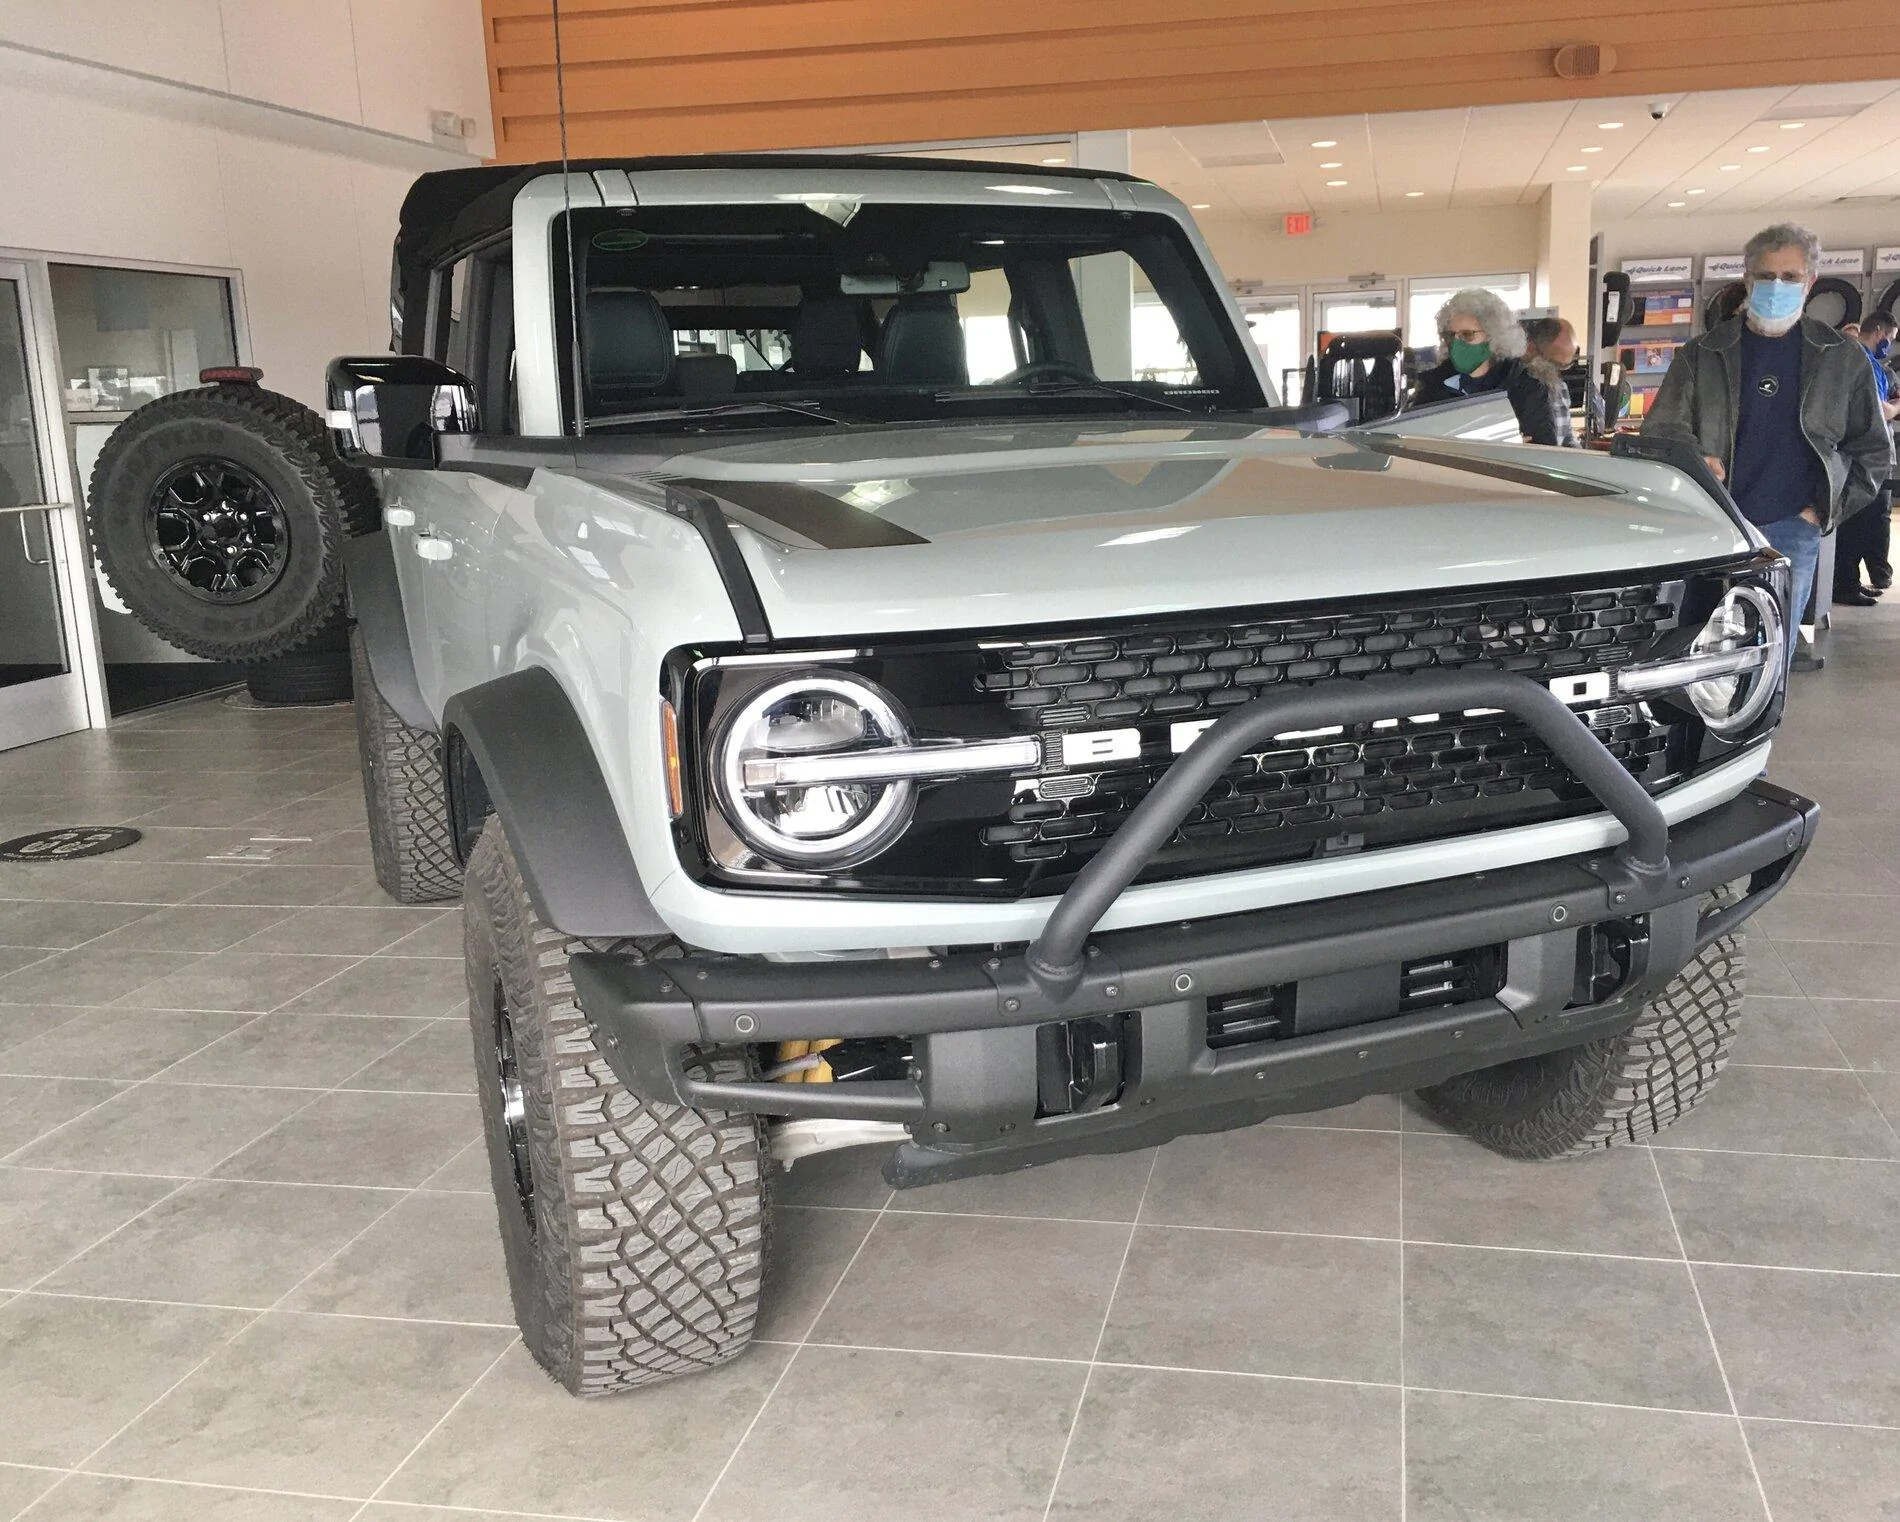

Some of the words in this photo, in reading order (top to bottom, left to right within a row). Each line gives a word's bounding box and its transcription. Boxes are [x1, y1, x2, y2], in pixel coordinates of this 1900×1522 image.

[1286, 215, 1310, 234] EXIT
[1835, 256, 1860, 264] Lane
[1636, 265, 1662, 274] Quick
